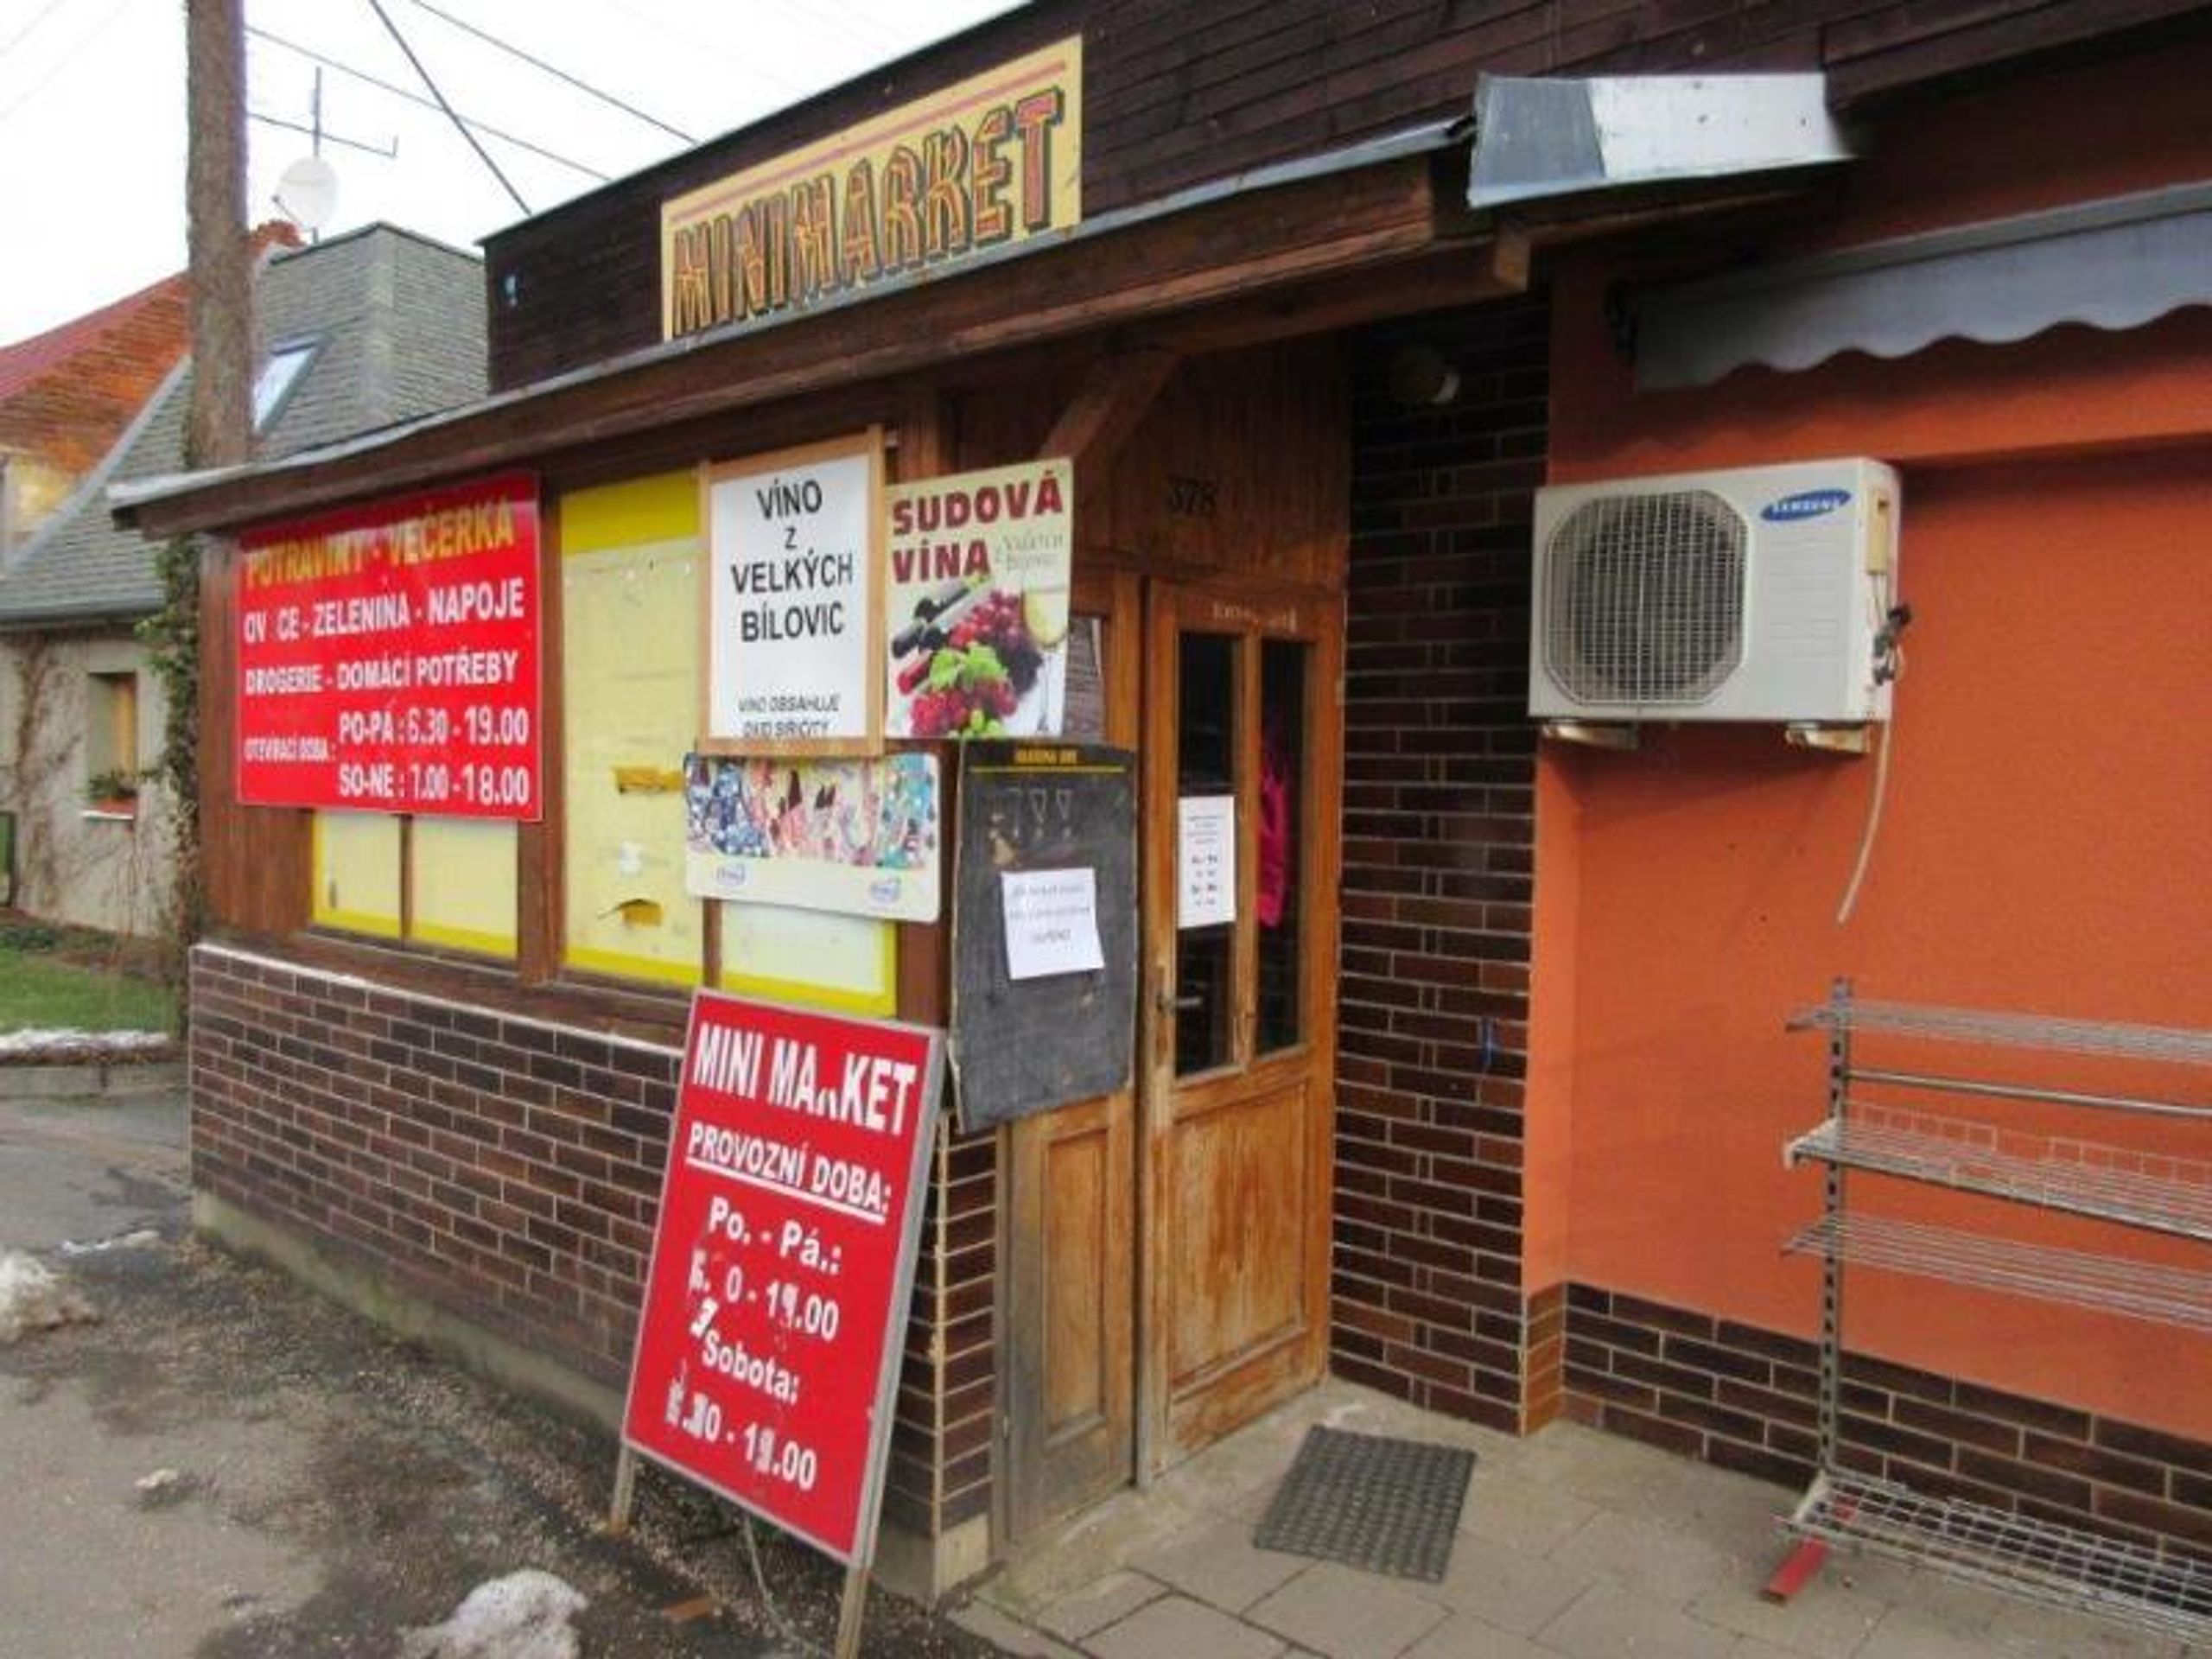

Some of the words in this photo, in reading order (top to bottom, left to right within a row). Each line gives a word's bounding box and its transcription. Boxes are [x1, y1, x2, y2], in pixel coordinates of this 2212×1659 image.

[673, 85, 1065, 338] MINIMARKET
[756, 479, 823, 519] VÍNO
[893, 470, 1064, 536] SUDOVÁ
[389, 499, 514, 566] VEČERKA
[893, 538, 991, 584] VÍNA
[731, 548, 854, 594] VELKÝCH
[312, 590, 411, 637] ZELENINA
[428, 577, 524, 626] NAPOJE
[741, 598, 845, 642] BÍLOVIC
[245, 664, 324, 696] DROGERIE
[336, 652, 411, 690] DOMÁCÍ
[416, 645, 519, 687] POTŘEBY
[464, 704, 530, 746] 19.00
[692, 1023, 764, 1101] MINI
[687, 1121, 809, 1187] PROVOZNÍ
[811, 1154, 892, 1214] DOBA:
[708, 1195, 751, 1245] Po.
[779, 1218, 842, 1275] Pá.:
[702, 1327, 799, 1405] Sobota:
